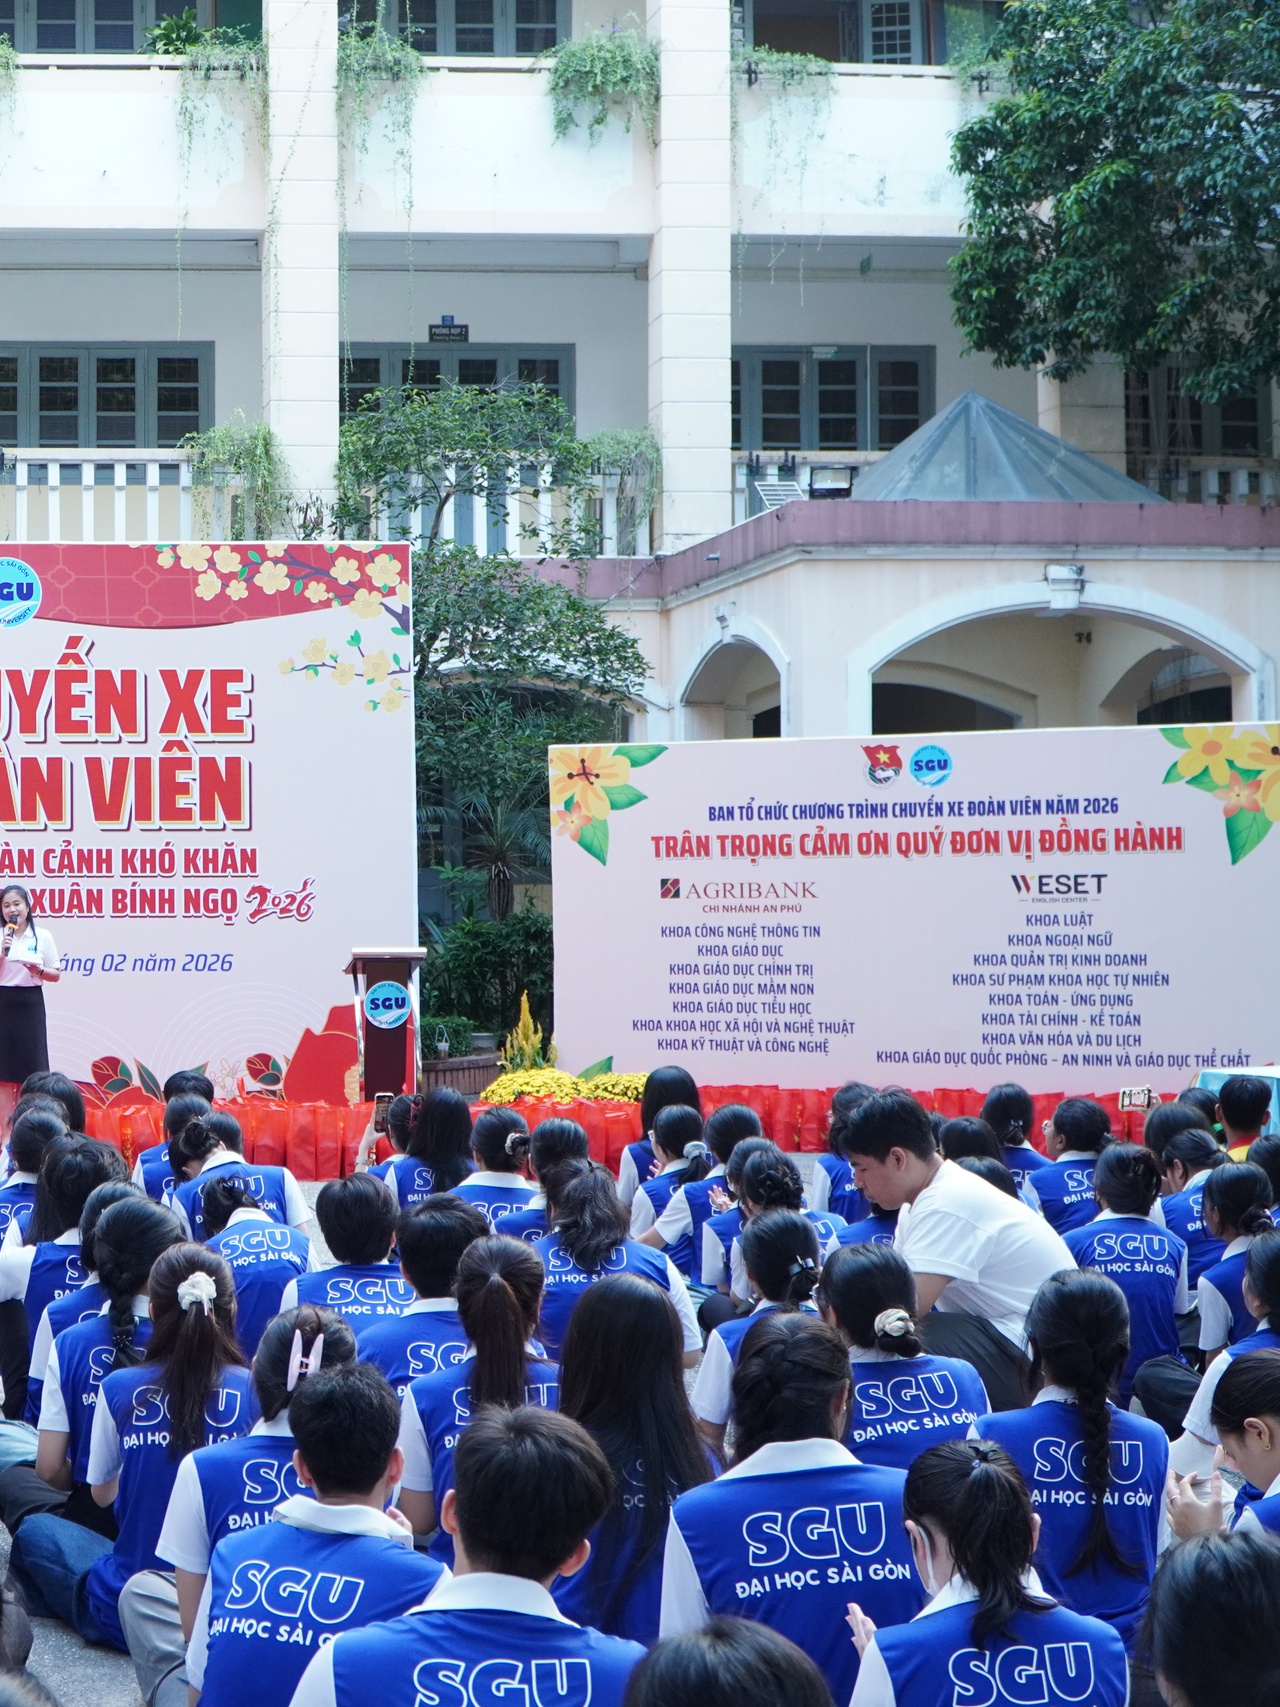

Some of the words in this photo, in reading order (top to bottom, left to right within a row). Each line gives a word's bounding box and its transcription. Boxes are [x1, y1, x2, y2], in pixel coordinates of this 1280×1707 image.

[159, 669, 245, 735] XE
[914, 759, 948, 772] SGU
[85, 738, 243, 823] VIÊN
[708, 805, 734, 821] BAN
[737, 797, 755, 820] TỔ
[757, 800, 788, 820] CHỨC
[792, 802, 844, 819] CHƯƠNG
[847, 798, 888, 818] TRÌNH
[891, 794, 943, 817] CHUYẾN
[947, 800, 964, 817] XE
[967, 795, 1005, 816] ĐOÀN
[1009, 795, 1041, 815] VIÊN
[1045, 794, 1079, 814] NĂM
[1083, 797, 1118, 814] 2026
[43, 840, 113, 874] CẢNH
[121, 842, 175, 874] KHÓ
[184, 843, 257, 874] KHĂN
[685, 882, 818, 898] AGRIBANK
[1010, 873, 1108, 894] WESET
[30, 883, 103, 914] XUÂN
[112, 882, 175, 914] BÍNH
[184, 889, 237, 921] NGỌ
[245, 878, 314, 920] 2026
[702, 904, 719, 913] CHI
[722, 903, 760, 913] NHÁNH
[762, 904, 777, 913] AN
[780, 902, 801, 913] PHÚ
[1026, 914, 1060, 926] KHOA
[1063, 911, 1093, 928] LUẬT
[697, 944, 728, 956] KHOA
[731, 942, 758, 956] GIÁO
[761, 945, 783, 959] DỤC
[1008, 934, 1042, 946] KHOA
[1045, 934, 1083, 948] NGOẠI
[1087, 931, 1113, 946] NGỮ
[59, 953, 95, 976] áng
[101, 953, 127, 972] 02
[132, 953, 176, 972] năm
[181, 953, 234, 972] 2026
[973, 954, 1007, 966] KHOA
[1010, 950, 1044, 967] QUẢN
[1048, 954, 1067, 969] TRỊ
[1071, 954, 1101, 966] KINH
[1104, 953, 1147, 966] DOANH
[370, 997, 406, 1010] SGU
[1094, 1233, 1169, 1261] SGU
[1107, 1262, 1132, 1274] HỌC
[1134, 1260, 1154, 1273] SÀI
[854, 1371, 958, 1419] SGU
[853, 1424, 883, 1443] ĐẠI
[884, 1419, 920, 1434] HỌC
[922, 1412, 950, 1429] SÀI
[951, 1408, 978, 1424] GÒN
[742, 1501, 886, 1567] SGU
[224, 1559, 365, 1624] SGU
[735, 1575, 770, 1599] ĐẠI
[774, 1569, 821, 1591] HỌC
[827, 1560, 863, 1584] SÀI
[868, 1558, 911, 1581] GÒN
[230, 1617, 272, 1639] HỌC
[275, 1621, 313, 1646] SÀI
[413, 1658, 592, 1707] SGU
[948, 1642, 1095, 1707] SGU
